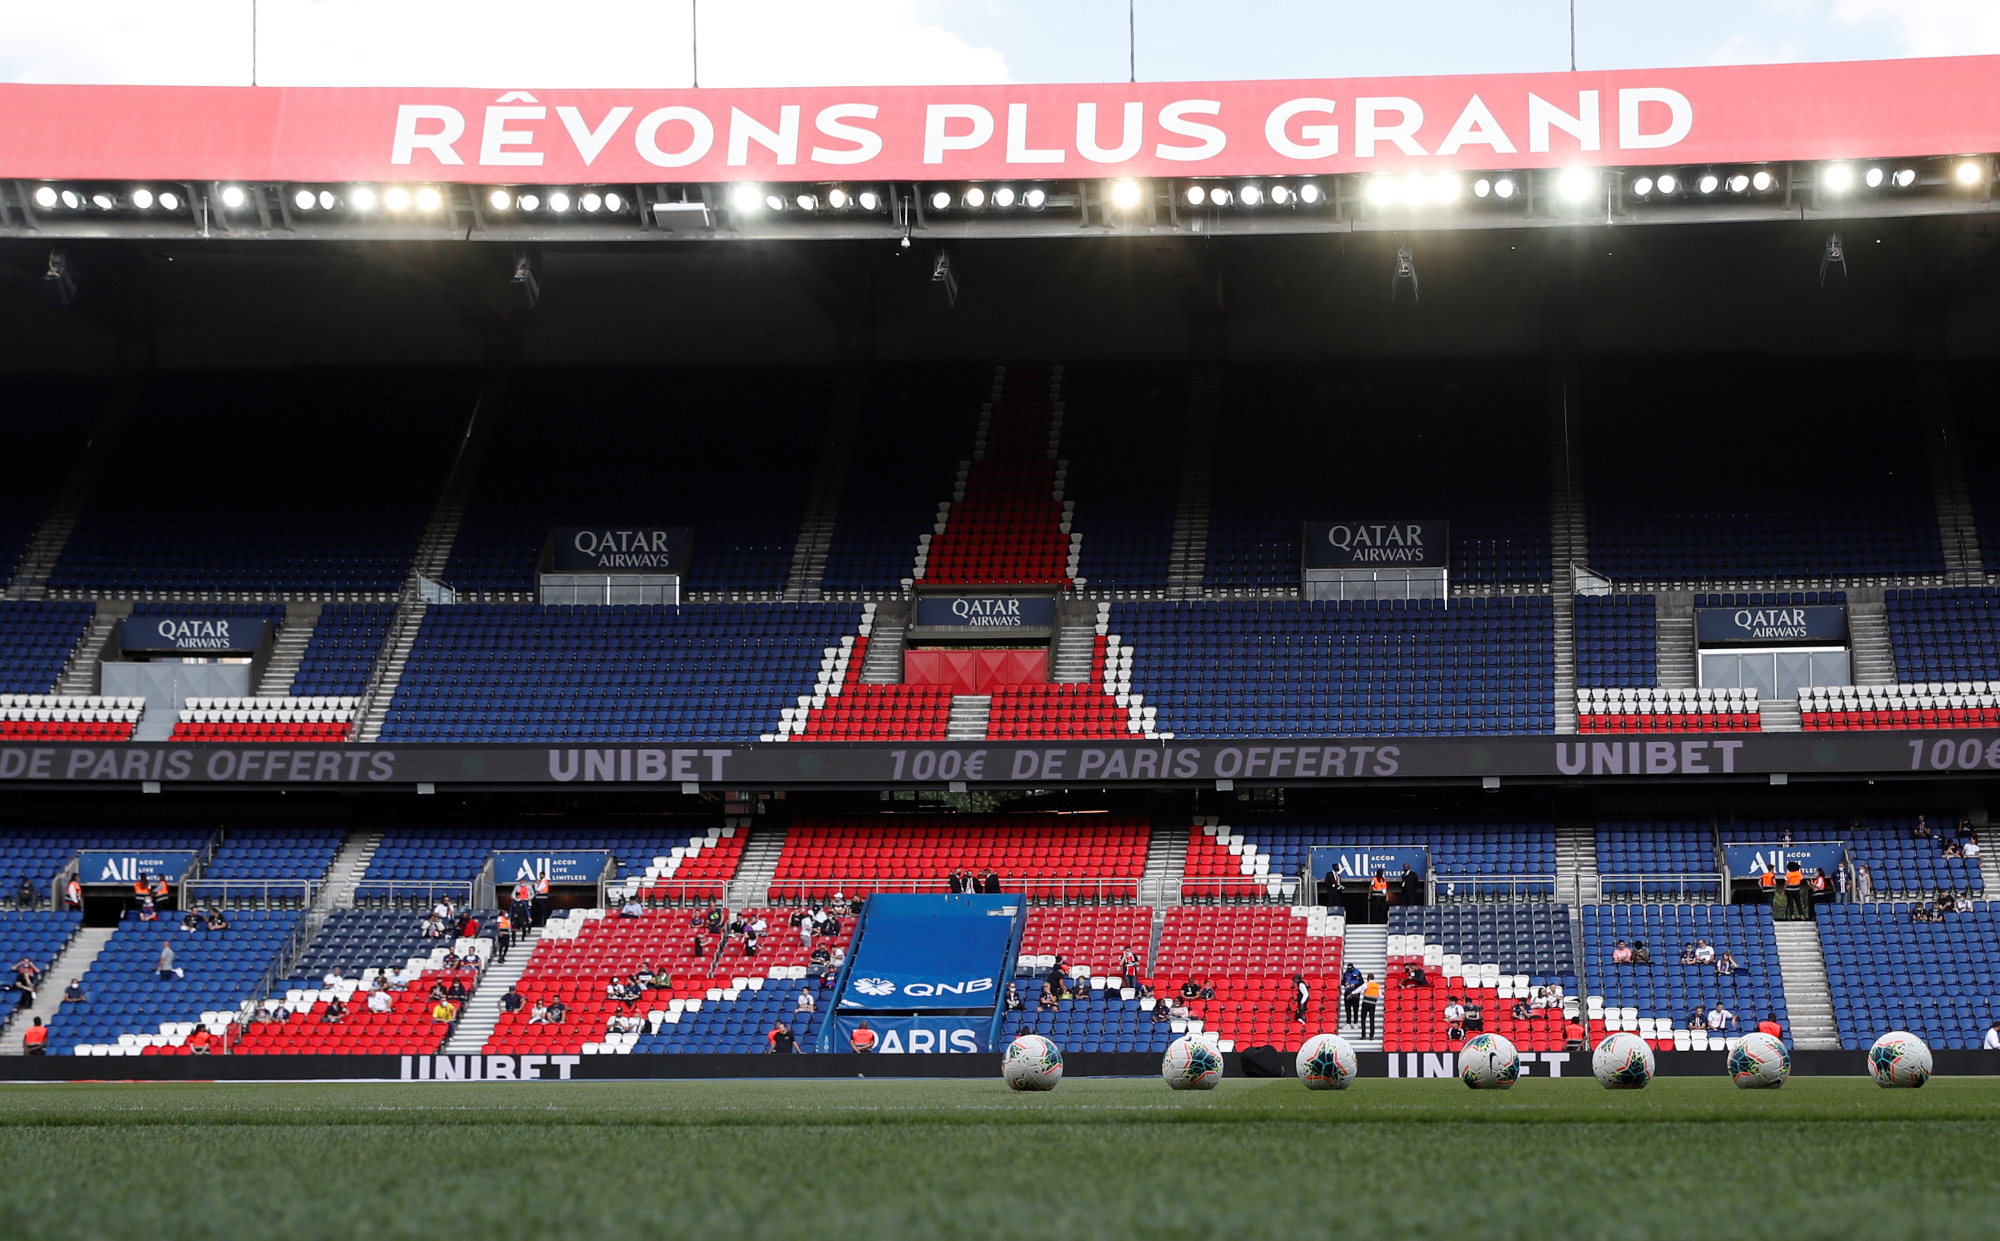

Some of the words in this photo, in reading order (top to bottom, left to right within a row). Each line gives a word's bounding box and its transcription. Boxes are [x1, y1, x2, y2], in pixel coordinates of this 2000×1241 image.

[390, 90, 883, 167] RÊVONS
[923, 99, 1228, 165] PLUS
[1264, 87, 1694, 160] GRAND
[574, 531, 669, 557] QATAR
[1328, 525, 1423, 552] QATAR
[598, 553, 669, 567] AIRWAYS
[1352, 547, 1424, 561] AIRWAYS
[952, 598, 1020, 619] QATAR
[158, 619, 230, 641] QATAR
[969, 616, 1021, 626] AIRWAYS
[1734, 609, 1806, 630] QATAR
[1752, 626, 1807, 638] AIRWAYS
[175, 637, 230, 649] AIRWAYS
[0, 749, 55, 779] DE
[66, 748, 193, 780] PARIS
[206, 750, 394, 781] OFFERTS
[548, 749, 733, 782] UNIBET
[890, 750, 988, 780] 100€
[1011, 749, 1066, 779] DE
[1078, 747, 1200, 779] PARIS
[1213, 745, 1400, 778] OFFERTS
[1555, 740, 1744, 776] UNIBET
[903, 978, 993, 997] QNB
